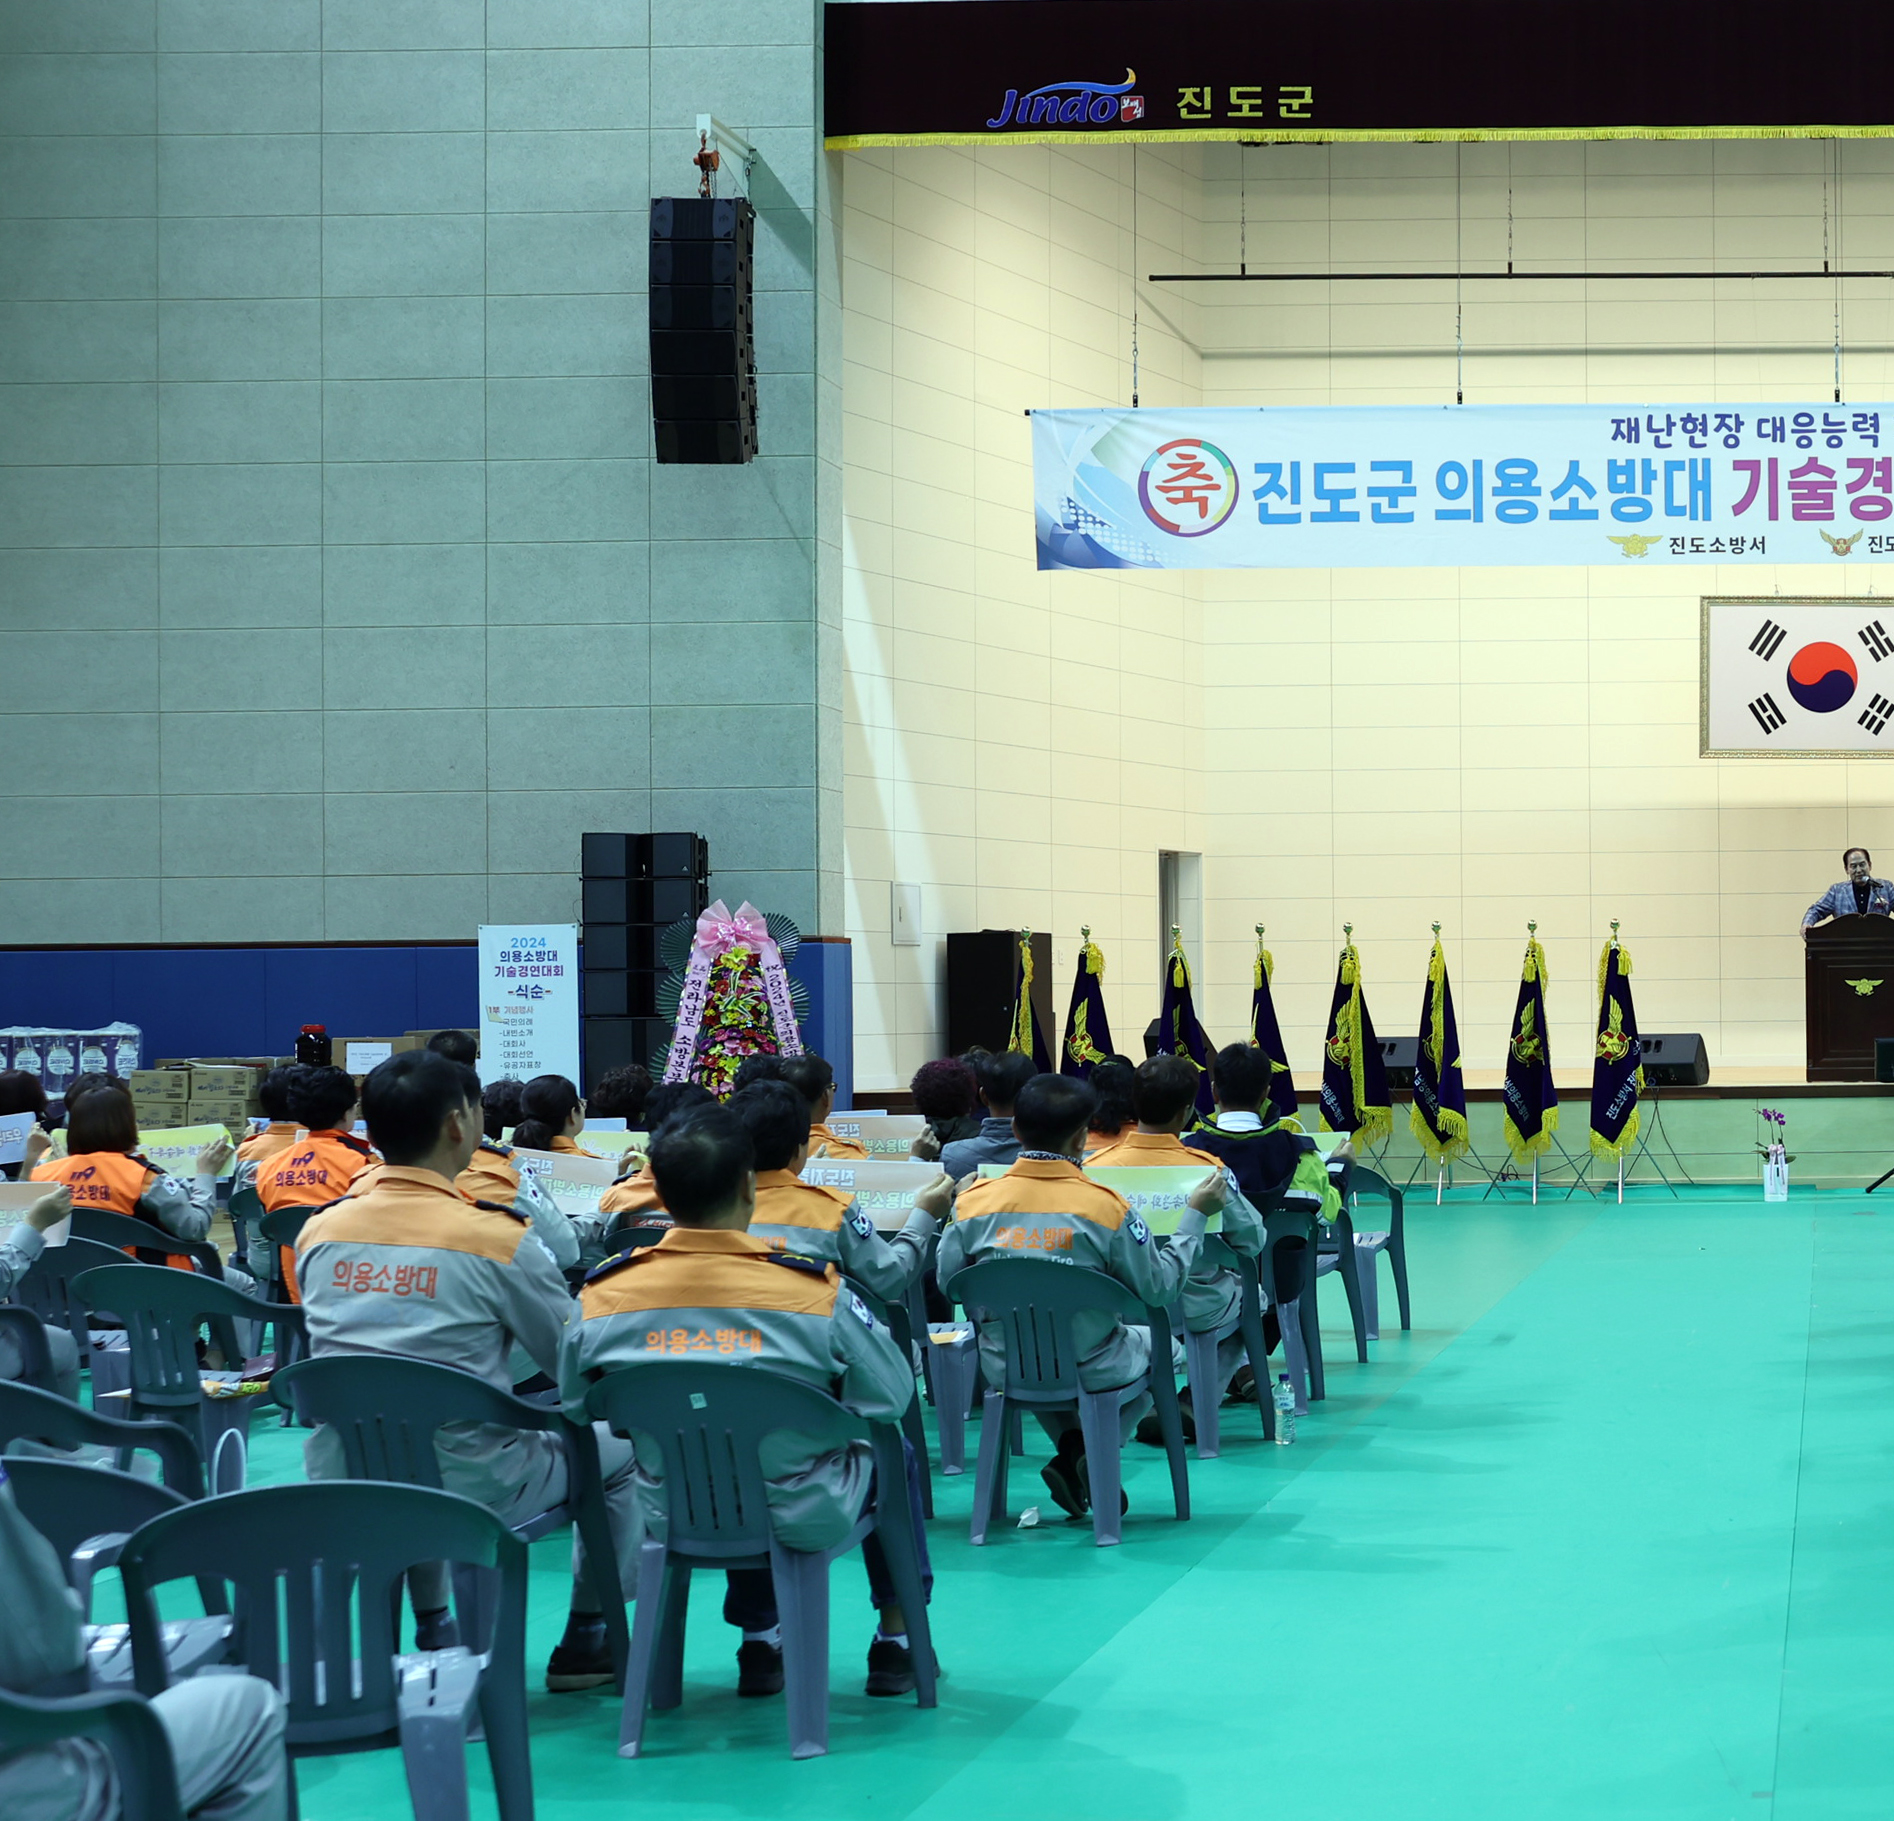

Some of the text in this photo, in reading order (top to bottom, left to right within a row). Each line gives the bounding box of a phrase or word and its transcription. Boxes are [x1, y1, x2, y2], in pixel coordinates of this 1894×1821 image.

[986, 84, 1118, 128] Jindo
[1177, 86, 1314, 120] 진도군
[1611, 412, 1745, 449] 재난현장
[1756, 412, 1881, 448] 대응능력
[1154, 453, 1222, 519] 축
[1252, 459, 1417, 525] 진도군
[1434, 457, 1712, 524] 의용소방대
[1669, 535, 1766, 555] 진도소방서
[500, 950, 558, 962] 의용소방대
[510, 937, 546, 948] 2024
[494, 965, 564, 977] 기술경연대회
[680, 979, 703, 1028] 전라남도
[275, 1167, 328, 1188] 의용소방대
[994, 1226, 1073, 1251] 의용소방대
[331, 1260, 438, 1299] 의용소방대
[645, 1327, 763, 1354] 의용소방대
